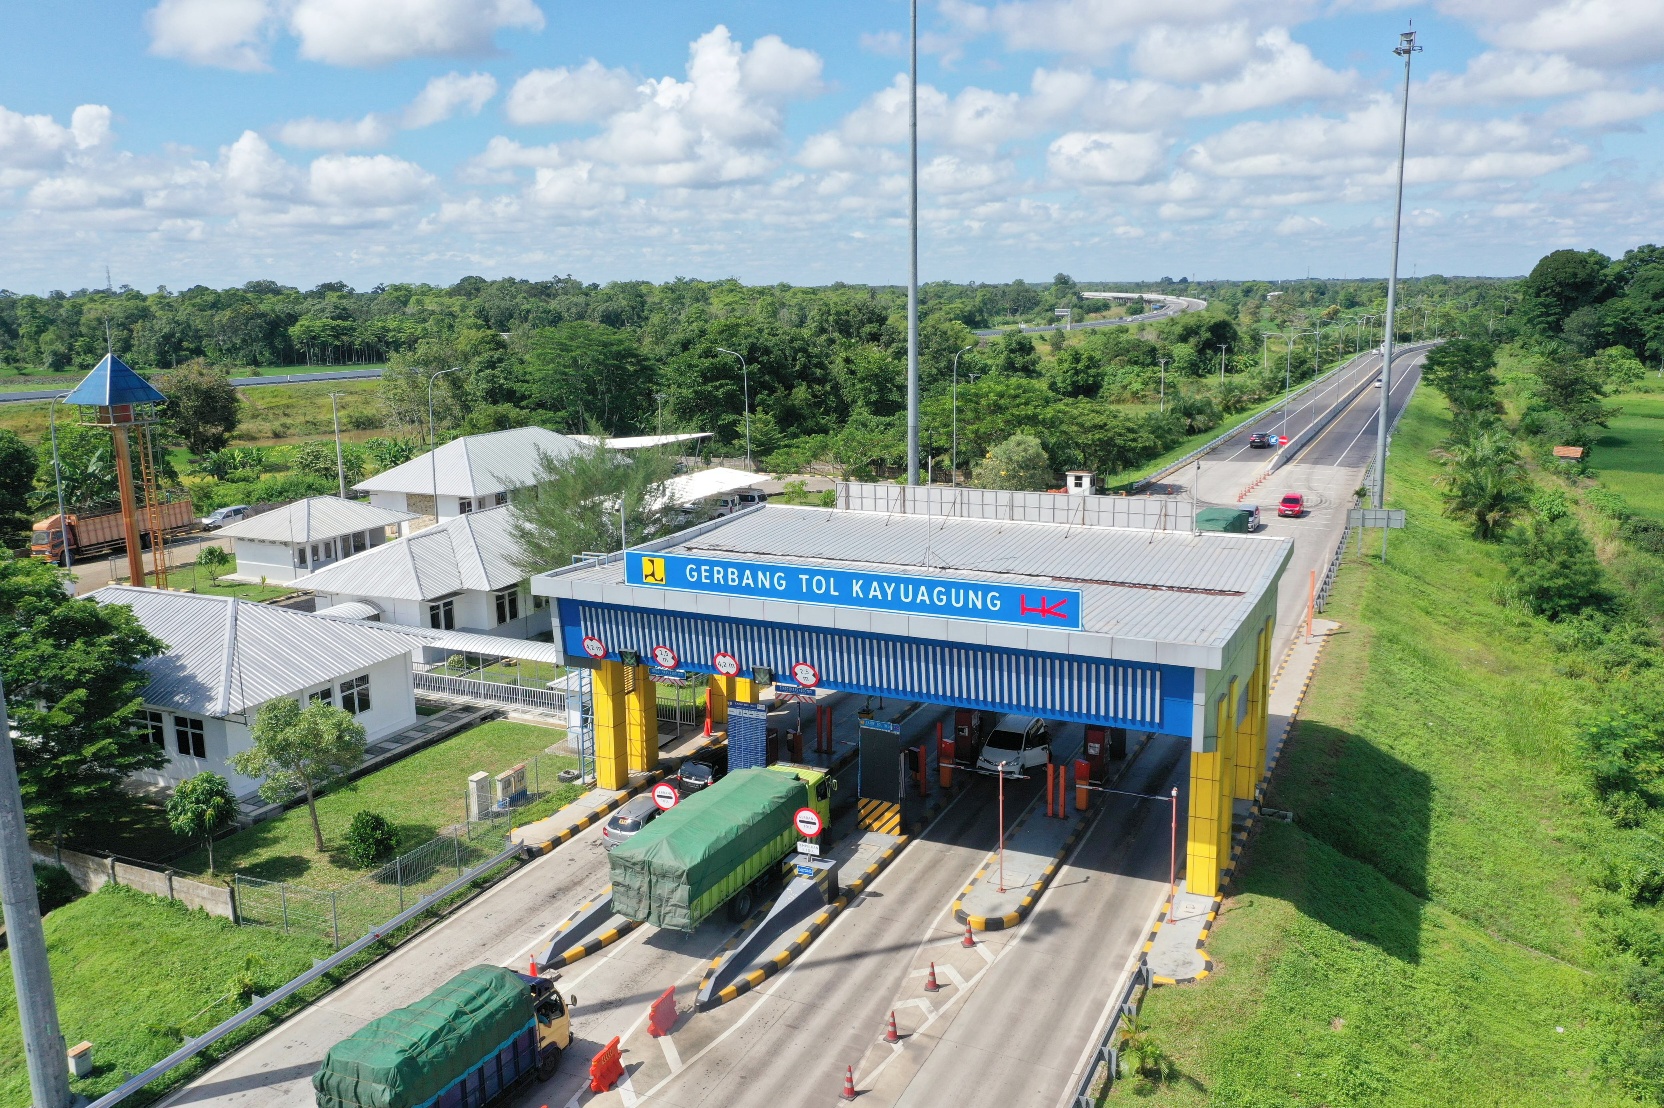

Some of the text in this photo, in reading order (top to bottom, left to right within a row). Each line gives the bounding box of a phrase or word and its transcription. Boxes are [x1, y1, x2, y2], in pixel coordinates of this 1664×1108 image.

[685, 563, 1001, 611] GERBANG TOL KAYUAGUNG
[1020, 594, 1068, 619] HK
